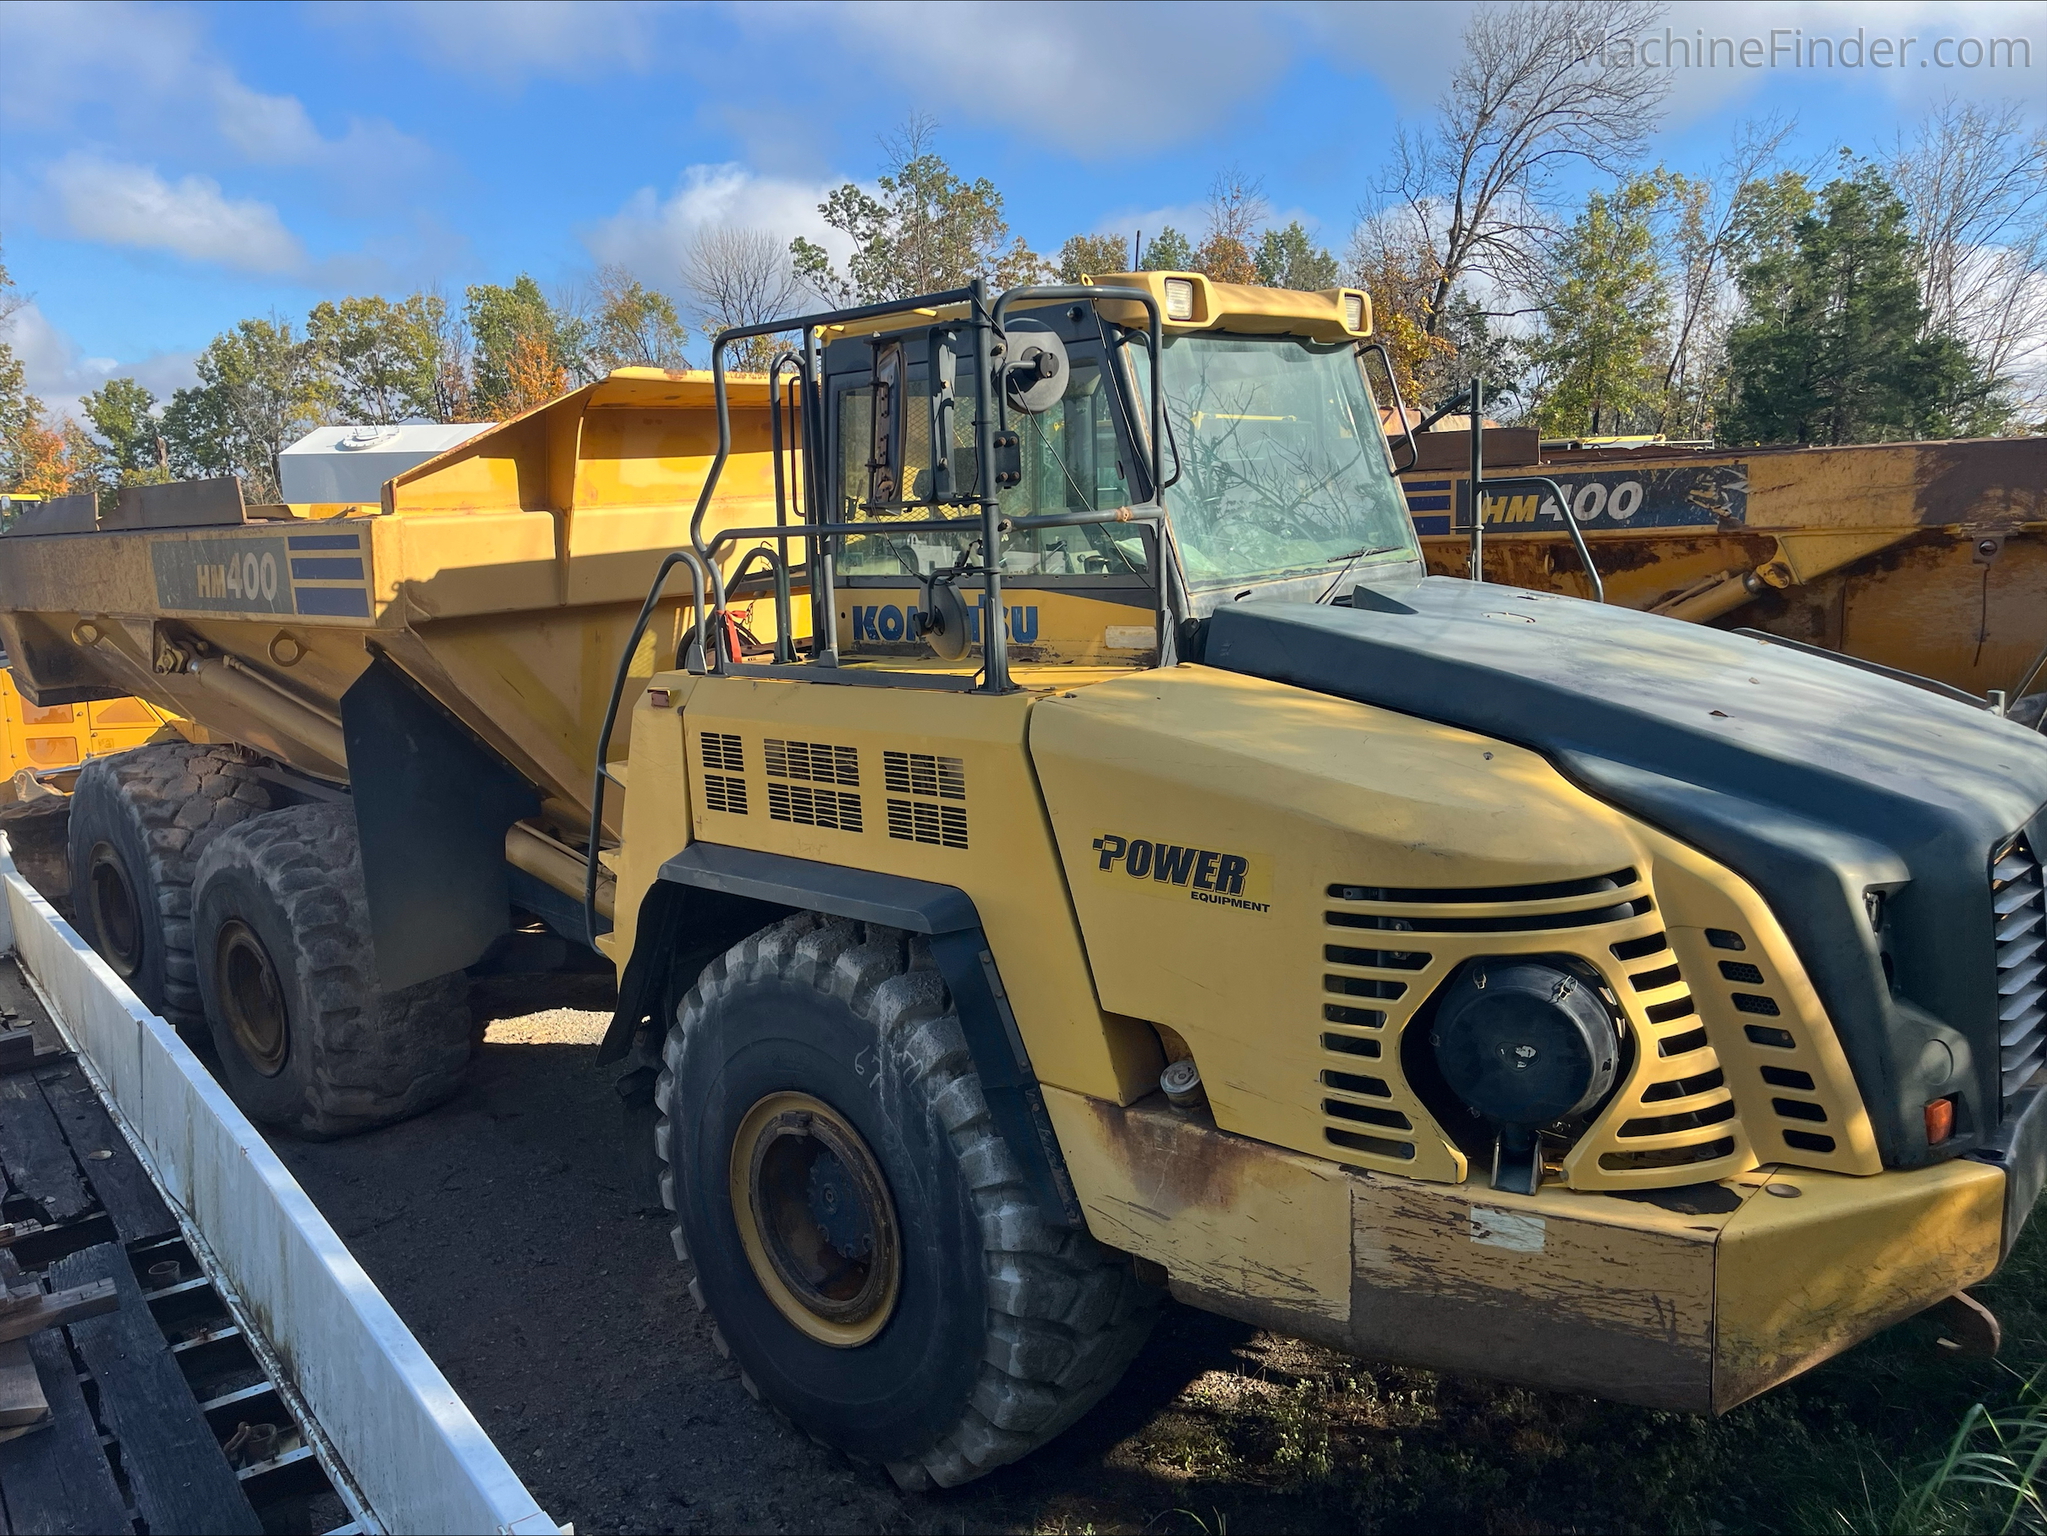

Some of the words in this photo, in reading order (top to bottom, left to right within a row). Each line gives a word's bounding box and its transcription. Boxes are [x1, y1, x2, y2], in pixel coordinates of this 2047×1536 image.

[196, 551, 278, 601] HM400
[1092, 834, 1249, 897] POWER
[1190, 891, 1271, 913] EQUIPMENT
